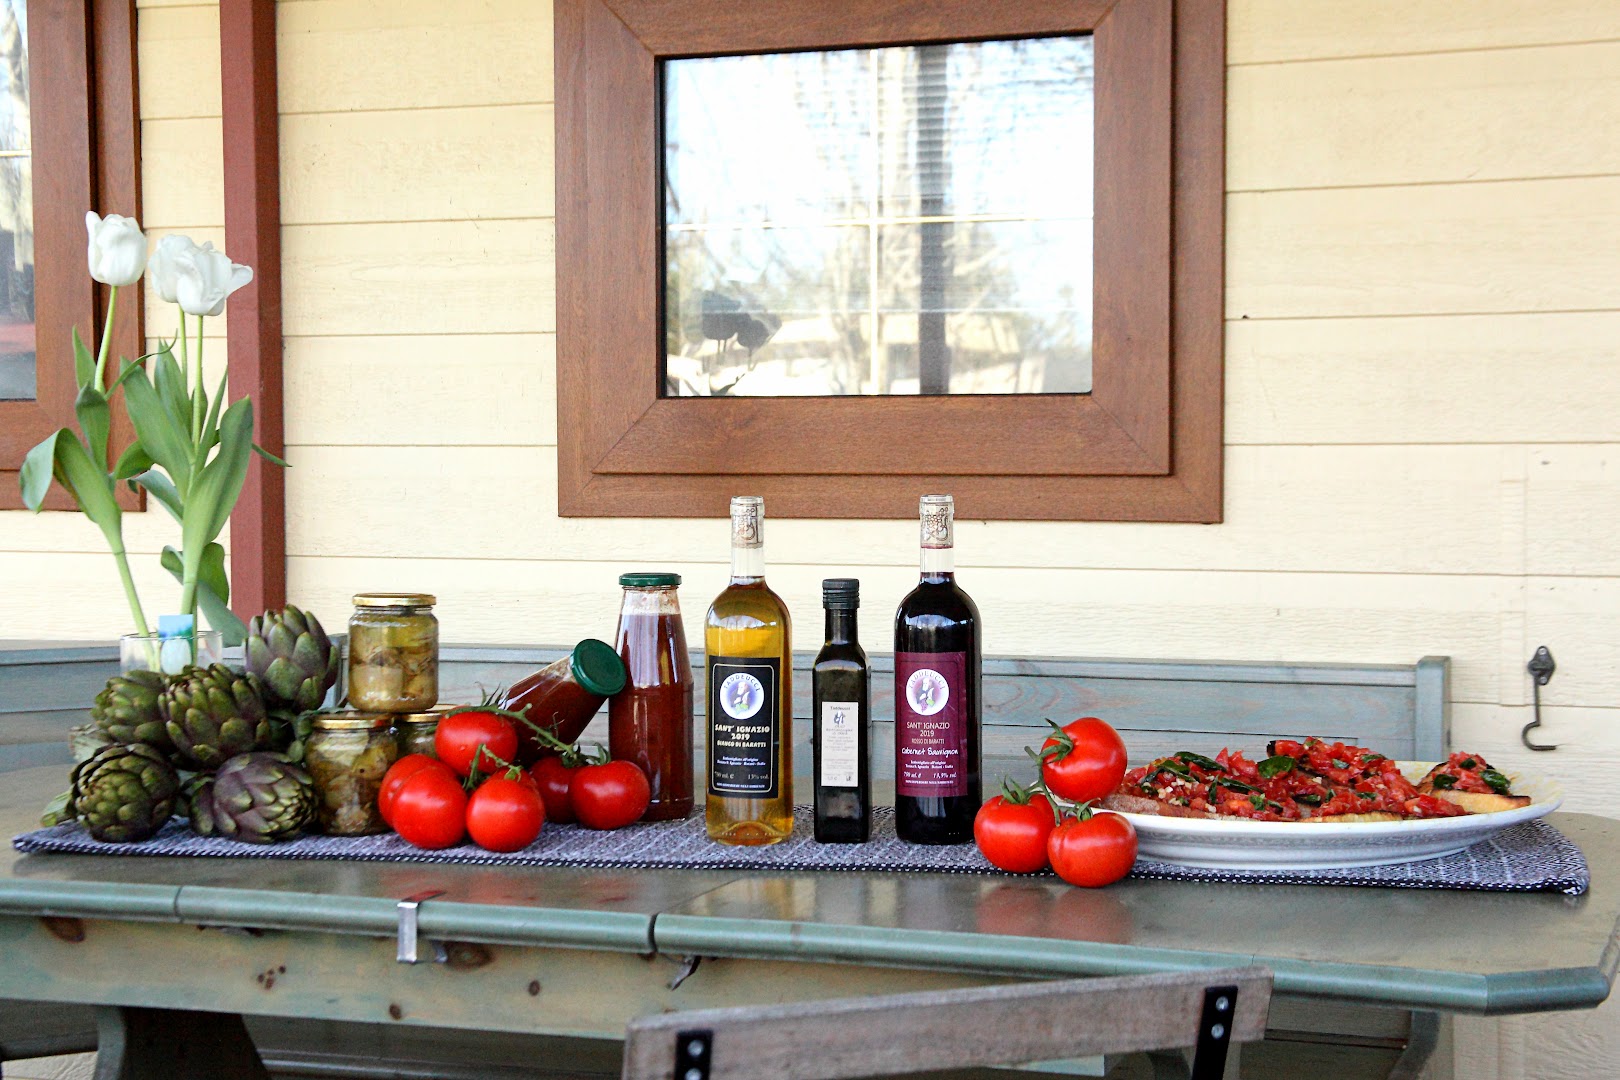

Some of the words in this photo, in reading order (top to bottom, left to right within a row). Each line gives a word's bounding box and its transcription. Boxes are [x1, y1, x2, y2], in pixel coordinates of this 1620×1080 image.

[724, 674, 760, 692] TADDEUCCI
[902, 747, 926, 755] Cabernet
[928, 747, 958, 758] Sauvignon
